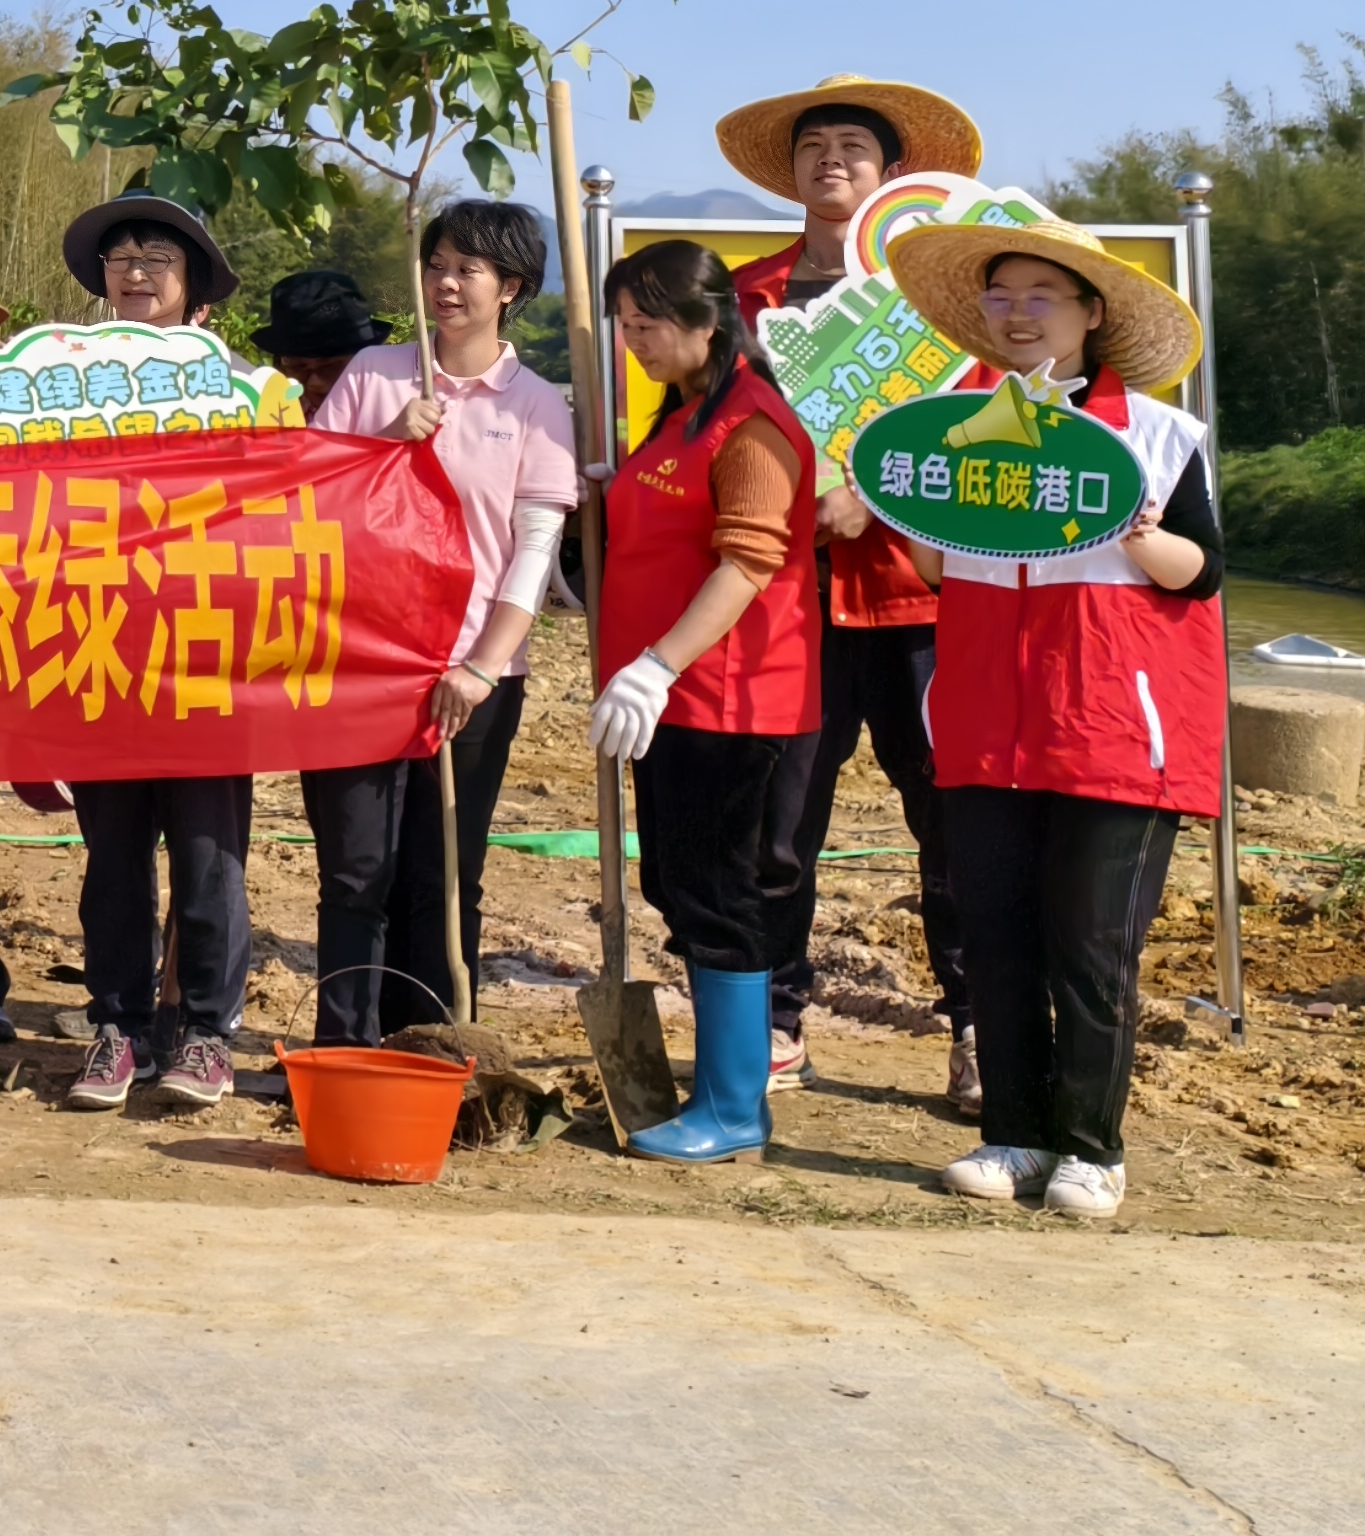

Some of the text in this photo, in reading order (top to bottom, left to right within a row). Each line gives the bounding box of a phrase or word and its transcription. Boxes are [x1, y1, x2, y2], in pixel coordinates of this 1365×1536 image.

[878, 448, 1110, 515] 绿色低碳港口
